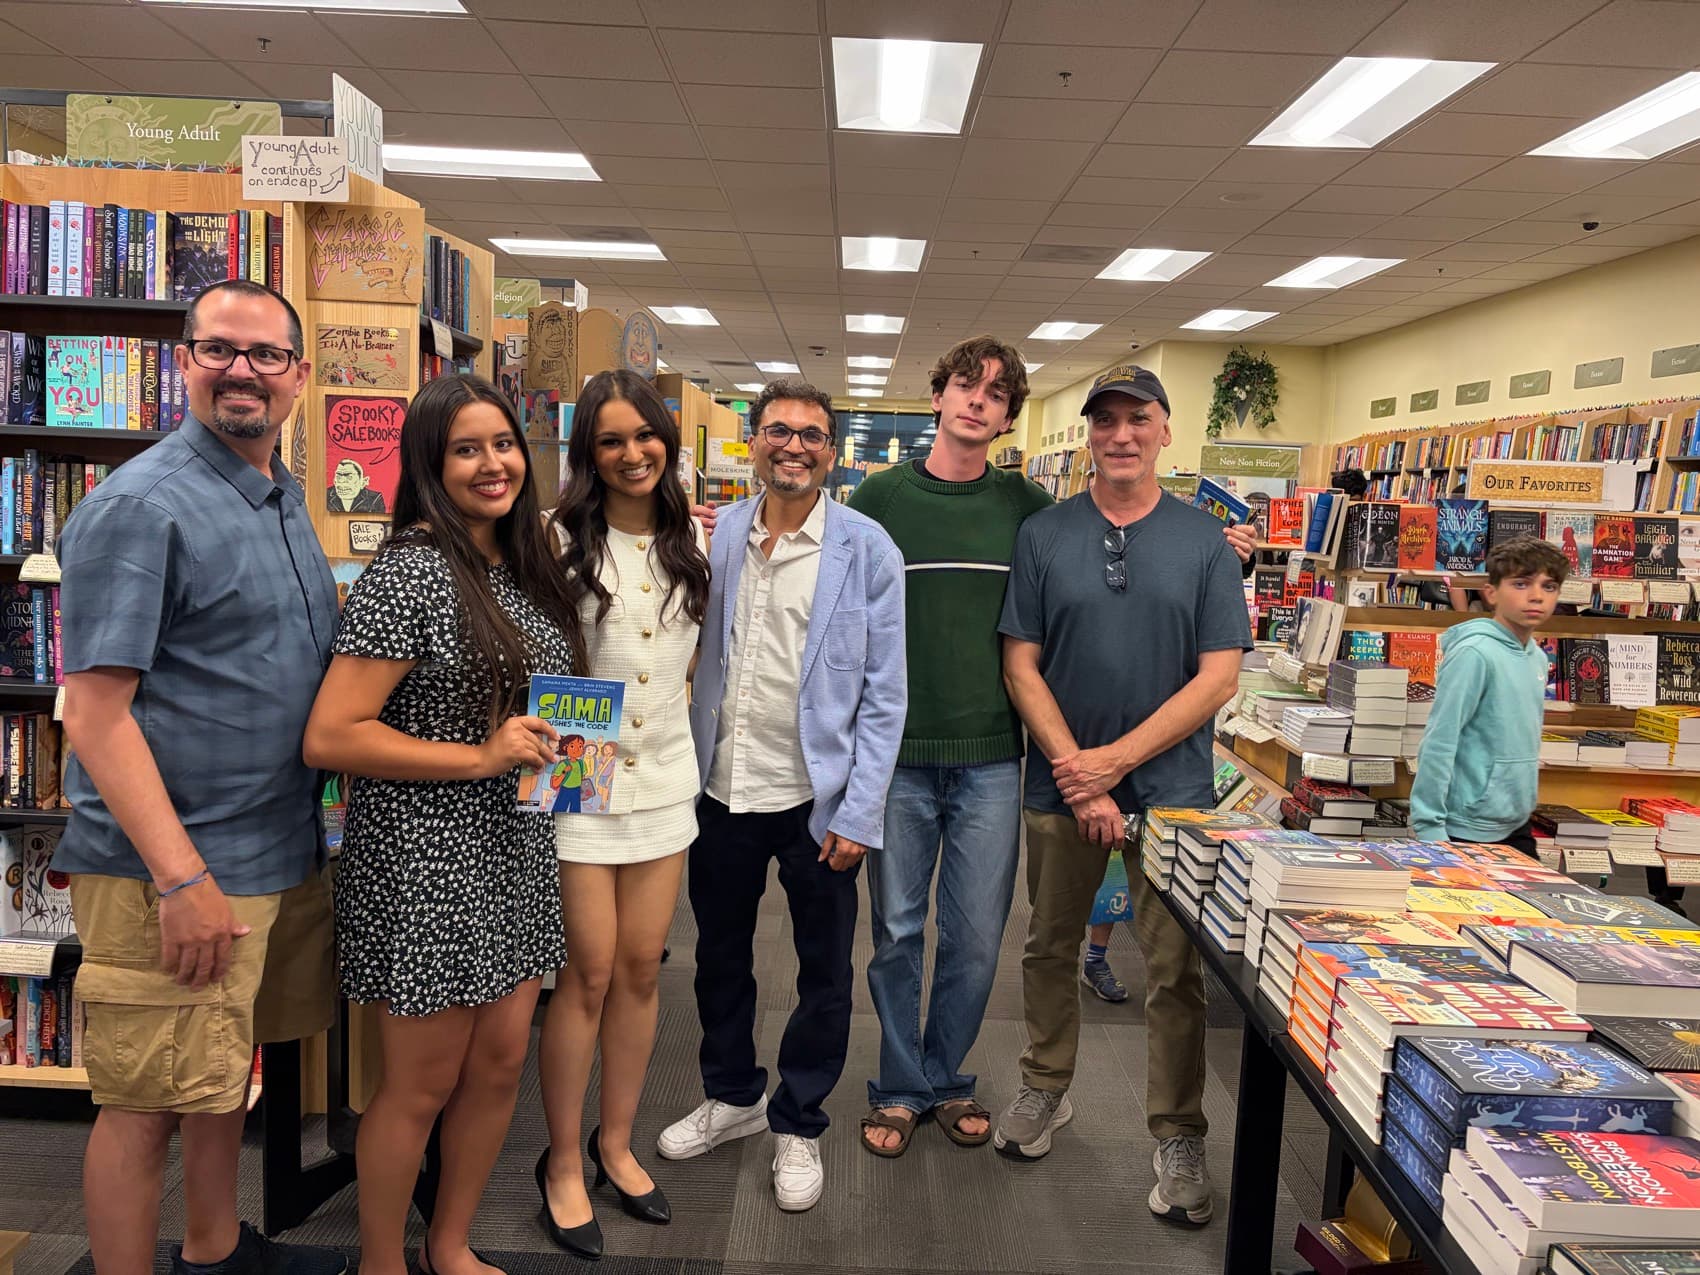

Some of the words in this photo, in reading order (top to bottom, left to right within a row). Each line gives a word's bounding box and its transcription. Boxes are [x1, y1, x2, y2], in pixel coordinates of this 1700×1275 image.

[336, 81, 381, 143] YOUNG
[125, 122, 174, 143] Young
[177, 124, 221, 142] Adult
[293, 138, 340, 167] Adult
[260, 164, 323, 177] continues
[248, 177, 264, 187] on
[266, 175, 319, 196] endcap
[104, 209, 114, 229] Soul
[179, 216, 194, 226] THE
[308, 206, 405, 244] Classic
[117, 211, 128, 257] MOONSICK
[193, 228, 226, 243] LIGHT
[103, 239, 114, 270] Shadow
[146, 229, 154, 270] ASAP
[273, 246, 281, 270] PAINTED
[495, 291, 524, 304] eligion
[318, 325, 362, 340] Zombie
[48, 338, 99, 350] BETTING
[337, 337, 348, 350] A
[13, 350, 23, 368] WISH
[65, 354, 83, 365] ON
[143, 355, 158, 404] MURTAGH
[49, 386, 100, 407] YOU
[338, 404, 399, 426] SPOOKY
[710, 466, 750, 474] MOLESKINE
[1219, 457, 1236, 467] New
[1238, 458, 1254, 467] Non
[1255, 458, 1281, 469] Fiction
[1174, 484, 1193, 493] Fiction
[1484, 474, 1515, 491] OUR
[1518, 475, 1592, 493] FAVORITES
[23, 474, 33, 515] MASQUERADE
[44, 483, 54, 514] TREACHERY
[1273, 500, 1303, 508] PUSHED
[1361, 510, 1399, 520] GIDEON
[1439, 508, 1485, 520] STRANGE
[351, 523, 371, 534] SALE
[1282, 519, 1303, 527] EDGE
[1440, 519, 1483, 532] ANIMALS
[1644, 524, 1667, 534] LEIGH
[23, 521, 33, 541] HEART
[43, 522, 54, 543] SWANS
[1634, 534, 1675, 545] BARDUGO
[1592, 549, 1634, 557] DAMNATION
[1634, 561, 1674, 576] familiar
[6, 601, 34, 616] STOL
[1357, 637, 1374, 645] THE
[1619, 644, 1644, 653] MIND
[1665, 638, 1700, 650] Rebecca
[36, 656, 44, 669] sky
[1392, 650, 1432, 662] POPPY
[1673, 653, 1693, 665] Ross
[1407, 665, 1431, 677] WAR
[1609, 662, 1653, 671] NUMBERS
[1673, 674, 1692, 688] Wild
[1569, 679, 1577, 701] BLOOD
[537, 692, 612, 723] SAMA
[546, 720, 572, 728] USHES
[43, 888, 71, 898] Rebecc
[1427, 984, 1503, 1020] WORLD
[1460, 982, 1518, 1004] RULE
[1501, 1007, 1553, 1029] THE
[1500, 985, 1560, 1006] HOW
[1542, 1010, 1587, 1024] TO
[42, 1022, 51, 1045] HEIST
[1420, 1036, 1522, 1091] BOUND
[1537, 1132, 1622, 1200] MISTBORN
[1570, 1132, 1665, 1205] SANDERSON
[1601, 1139, 1673, 1197] BRANDON
